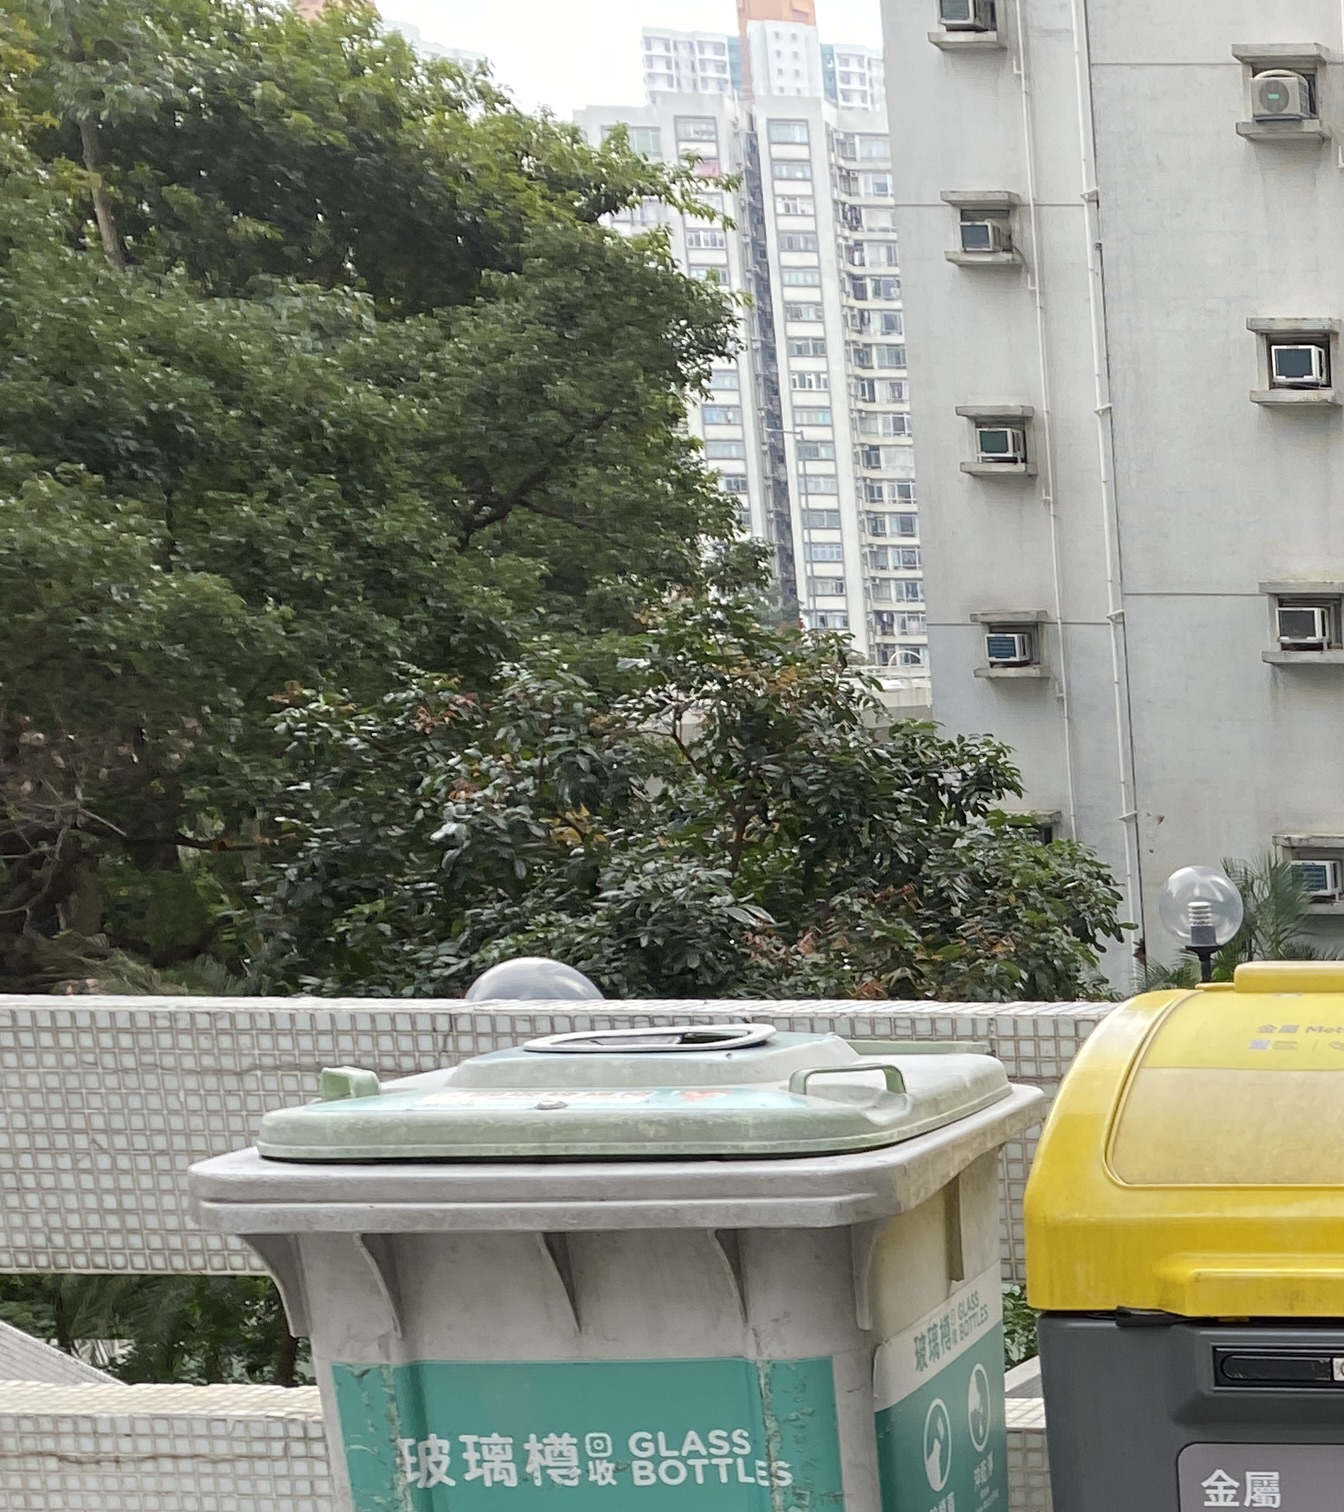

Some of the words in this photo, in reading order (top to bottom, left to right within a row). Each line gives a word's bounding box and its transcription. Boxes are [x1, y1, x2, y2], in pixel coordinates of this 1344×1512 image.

[628, 1428, 752, 1458] GLASS
[631, 1457, 794, 1487] BOTTLES
[1201, 1469, 1282, 1509] 金屬
